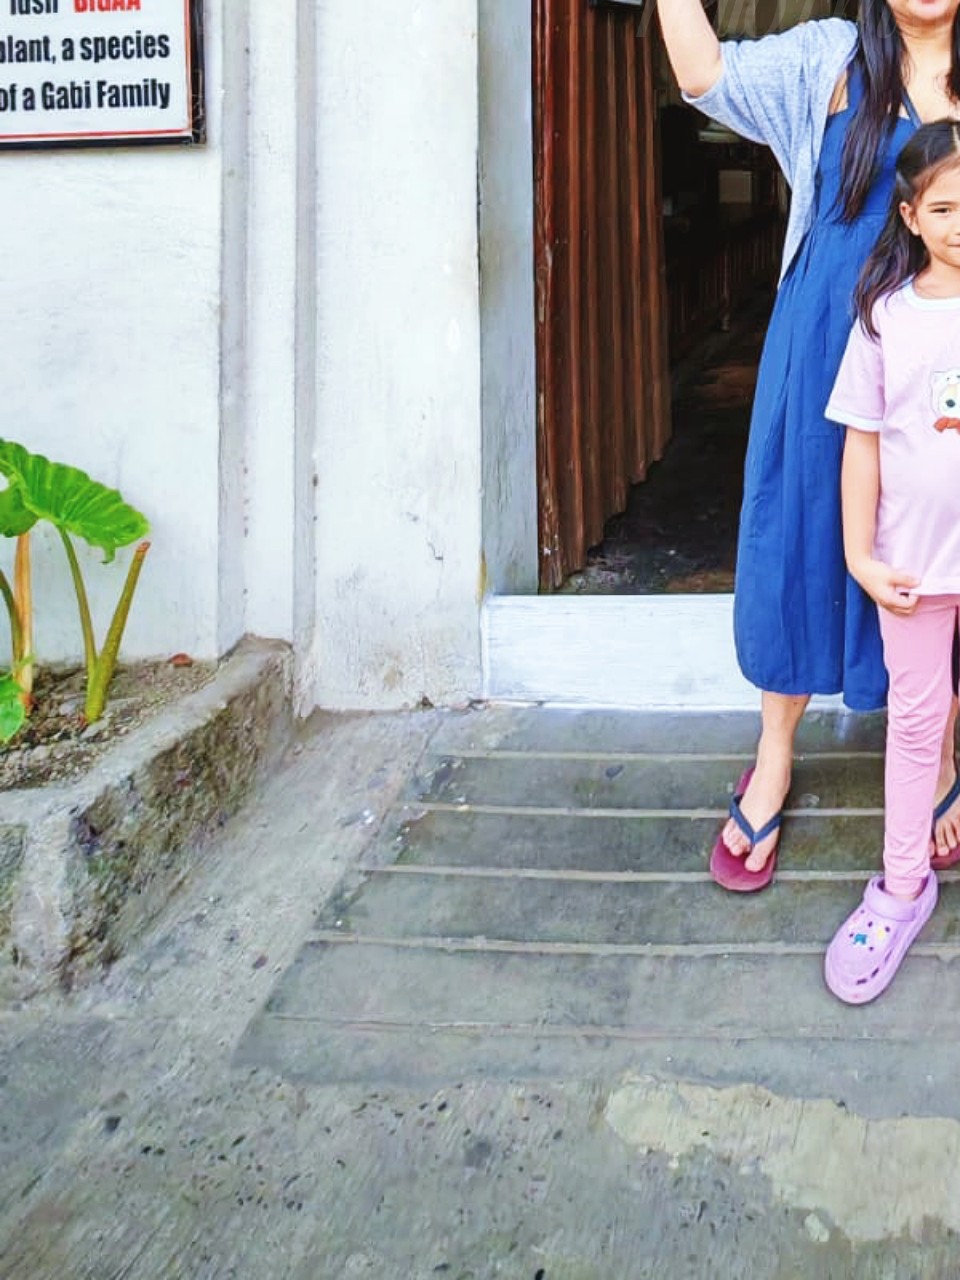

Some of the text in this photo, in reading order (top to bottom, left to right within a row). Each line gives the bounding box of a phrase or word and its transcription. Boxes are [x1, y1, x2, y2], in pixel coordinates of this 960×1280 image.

[61, 39, 75, 61] a
[80, 31, 170, 64] species
[22, 87, 36, 111] a
[41, 80, 92, 110] Gabi
[97, 78, 171, 109] Family
